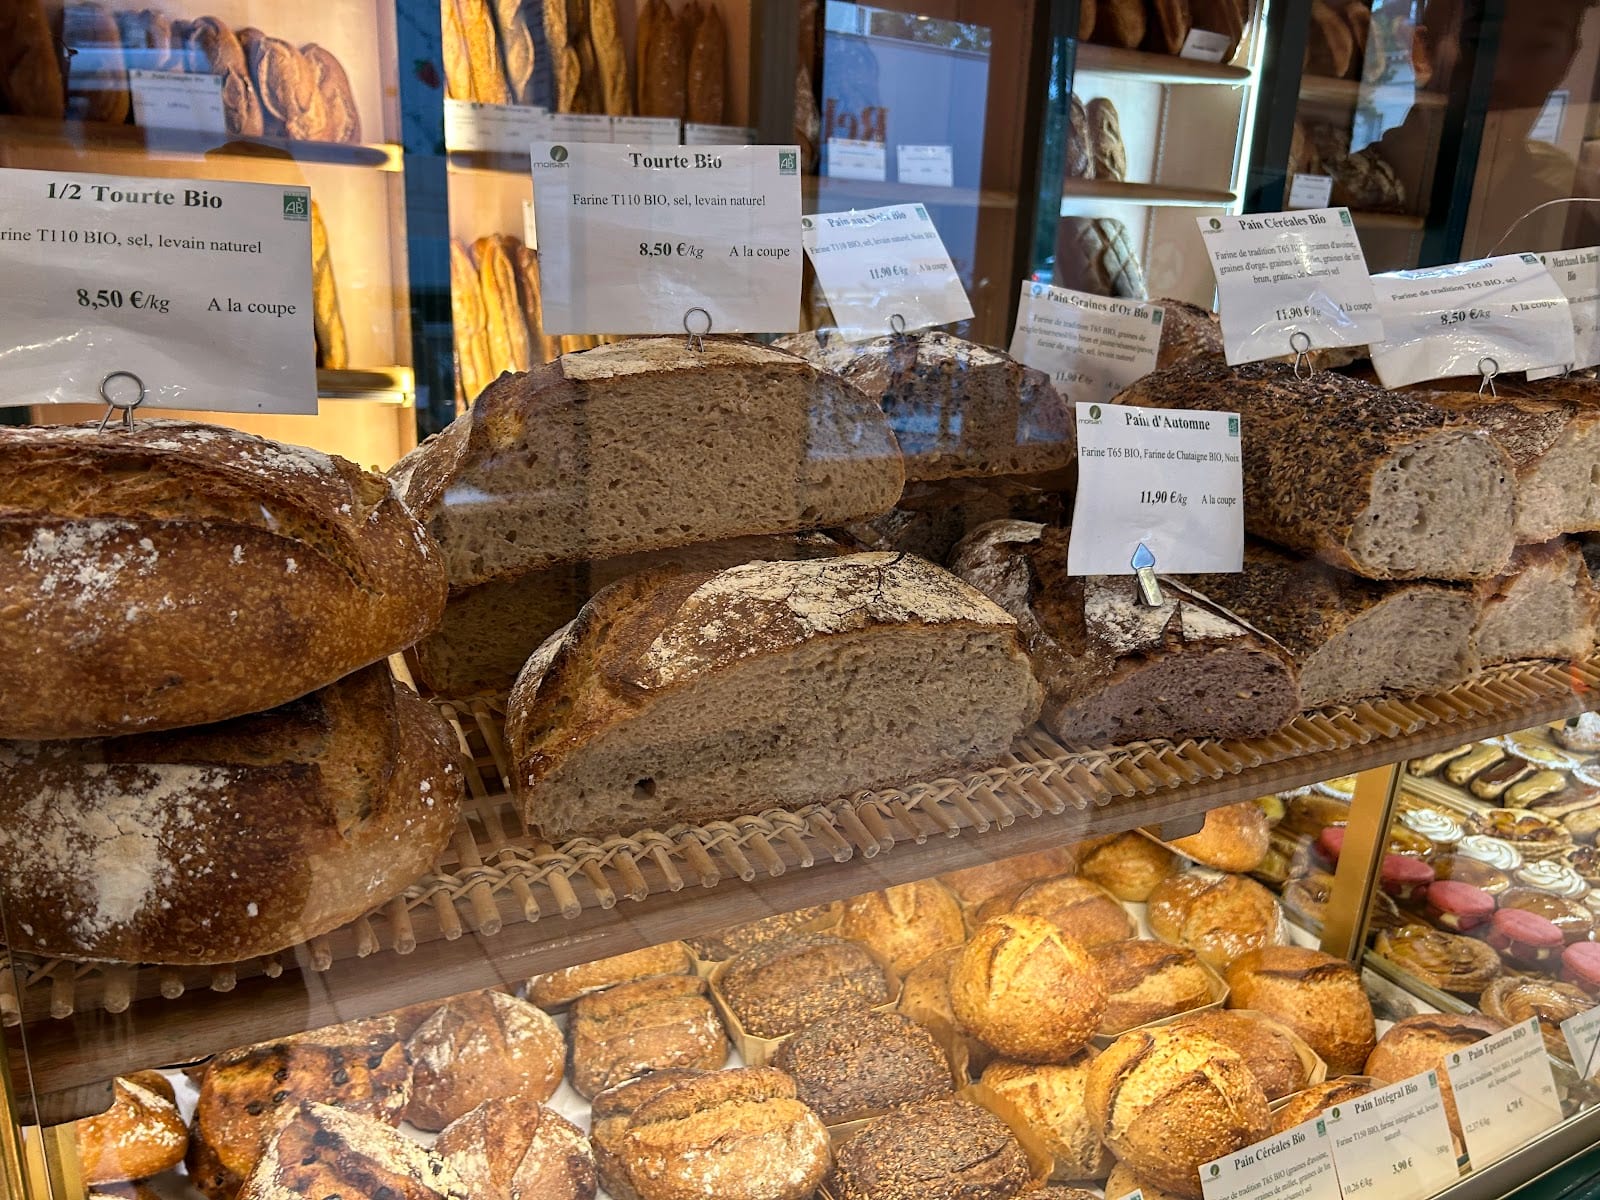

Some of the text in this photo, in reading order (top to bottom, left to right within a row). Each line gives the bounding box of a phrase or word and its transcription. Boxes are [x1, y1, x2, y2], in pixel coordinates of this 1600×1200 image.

[629, 152, 722, 169] Tourte Bio
[47, 182, 223, 209] 1/2 Tourte Bio
[572, 194, 766, 208] Farine T110 BIO, sel, levain naturel
[286, 201, 305, 214] AB
[827, 215, 848, 228] Pain
[1238, 214, 1326, 231] Pain Céréales Bio
[37, 228, 78, 243] T110
[84, 231, 122, 246] BIO,
[127, 234, 153, 248] sel,
[159, 235, 205, 250] levain
[210, 241, 262, 254] naturel
[639, 242, 704, 259] 8,50 €/kg
[729, 245, 790, 260] A la coupe
[1215, 251, 1237, 260] Farine
[1249, 246, 1276, 257] tradition
[1277, 245, 1290, 254] T65
[869, 267, 892, 280] 11,90
[1220, 264, 1244, 275] graines
[1270, 259, 1292, 270] graines
[1253, 274, 1271, 284] brun,
[77, 288, 170, 313] 8,50 €/kg
[1391, 292, 1418, 301] Farine
[1430, 285, 1465, 294] tradition
[208, 299, 296, 315] A la coupe
[1048, 291, 1149, 319] Pain Graines d'Or Bio
[1353, 301, 1372, 312] coupe
[1510, 304, 1520, 313] A
[1521, 302, 1530, 311] la
[1276, 307, 1303, 321] 11,90
[1152, 415, 1210, 431] d'Automne
[1081, 447, 1239, 463] Farine T65 BIO, Farine de Chataigne BIO, Noix
[1140, 491, 1188, 506] 11,90 €/kg
[1201, 494, 1236, 506] A la coupe
[1354, 1083, 1418, 1115] Pain Intégral Bio
[1234, 1131, 1306, 1170] Pain Céréales Bio
[1392, 1160, 1407, 1175] 3,90
